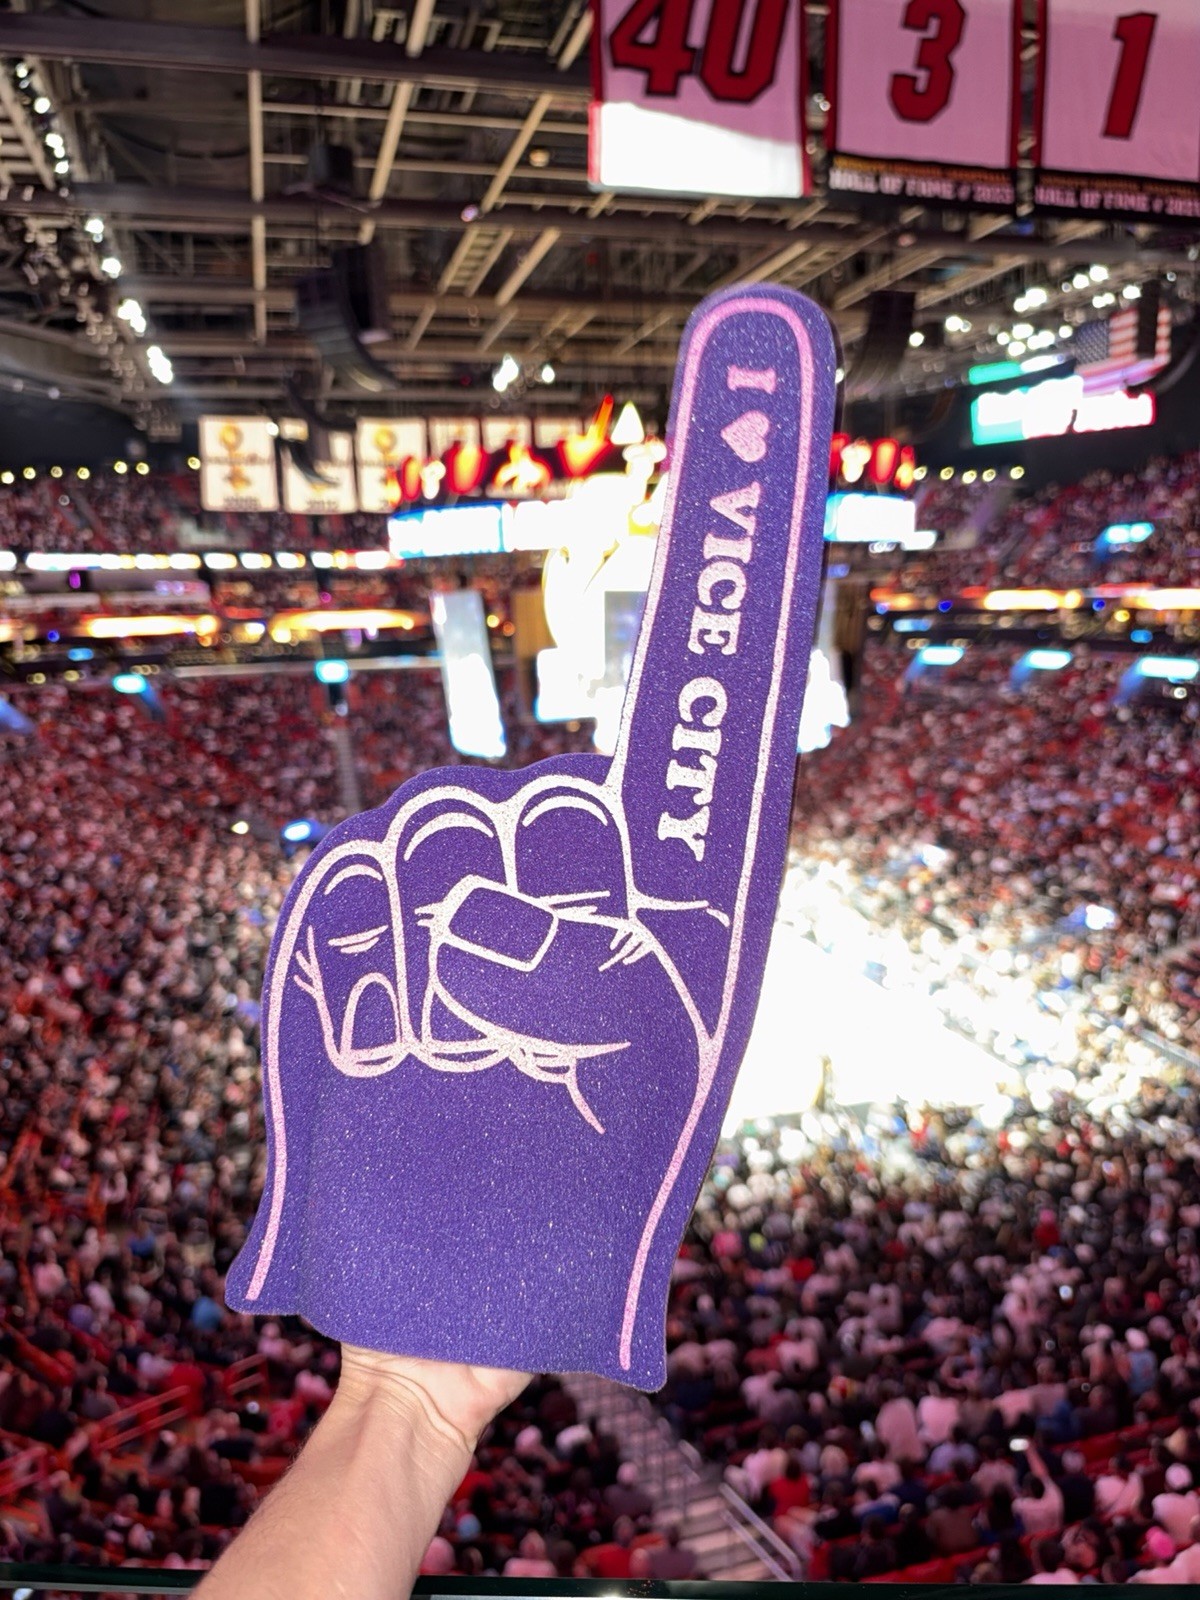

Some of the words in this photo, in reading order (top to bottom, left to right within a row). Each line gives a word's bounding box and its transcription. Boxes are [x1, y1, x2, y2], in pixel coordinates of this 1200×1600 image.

[609, 0, 788, 104] 40
[889, 0, 967, 123] 3
[1102, 11, 1158, 139] 1
[727, 365, 777, 395] I
[687, 481, 761, 655] VICE
[657, 676, 729, 862] CITY
